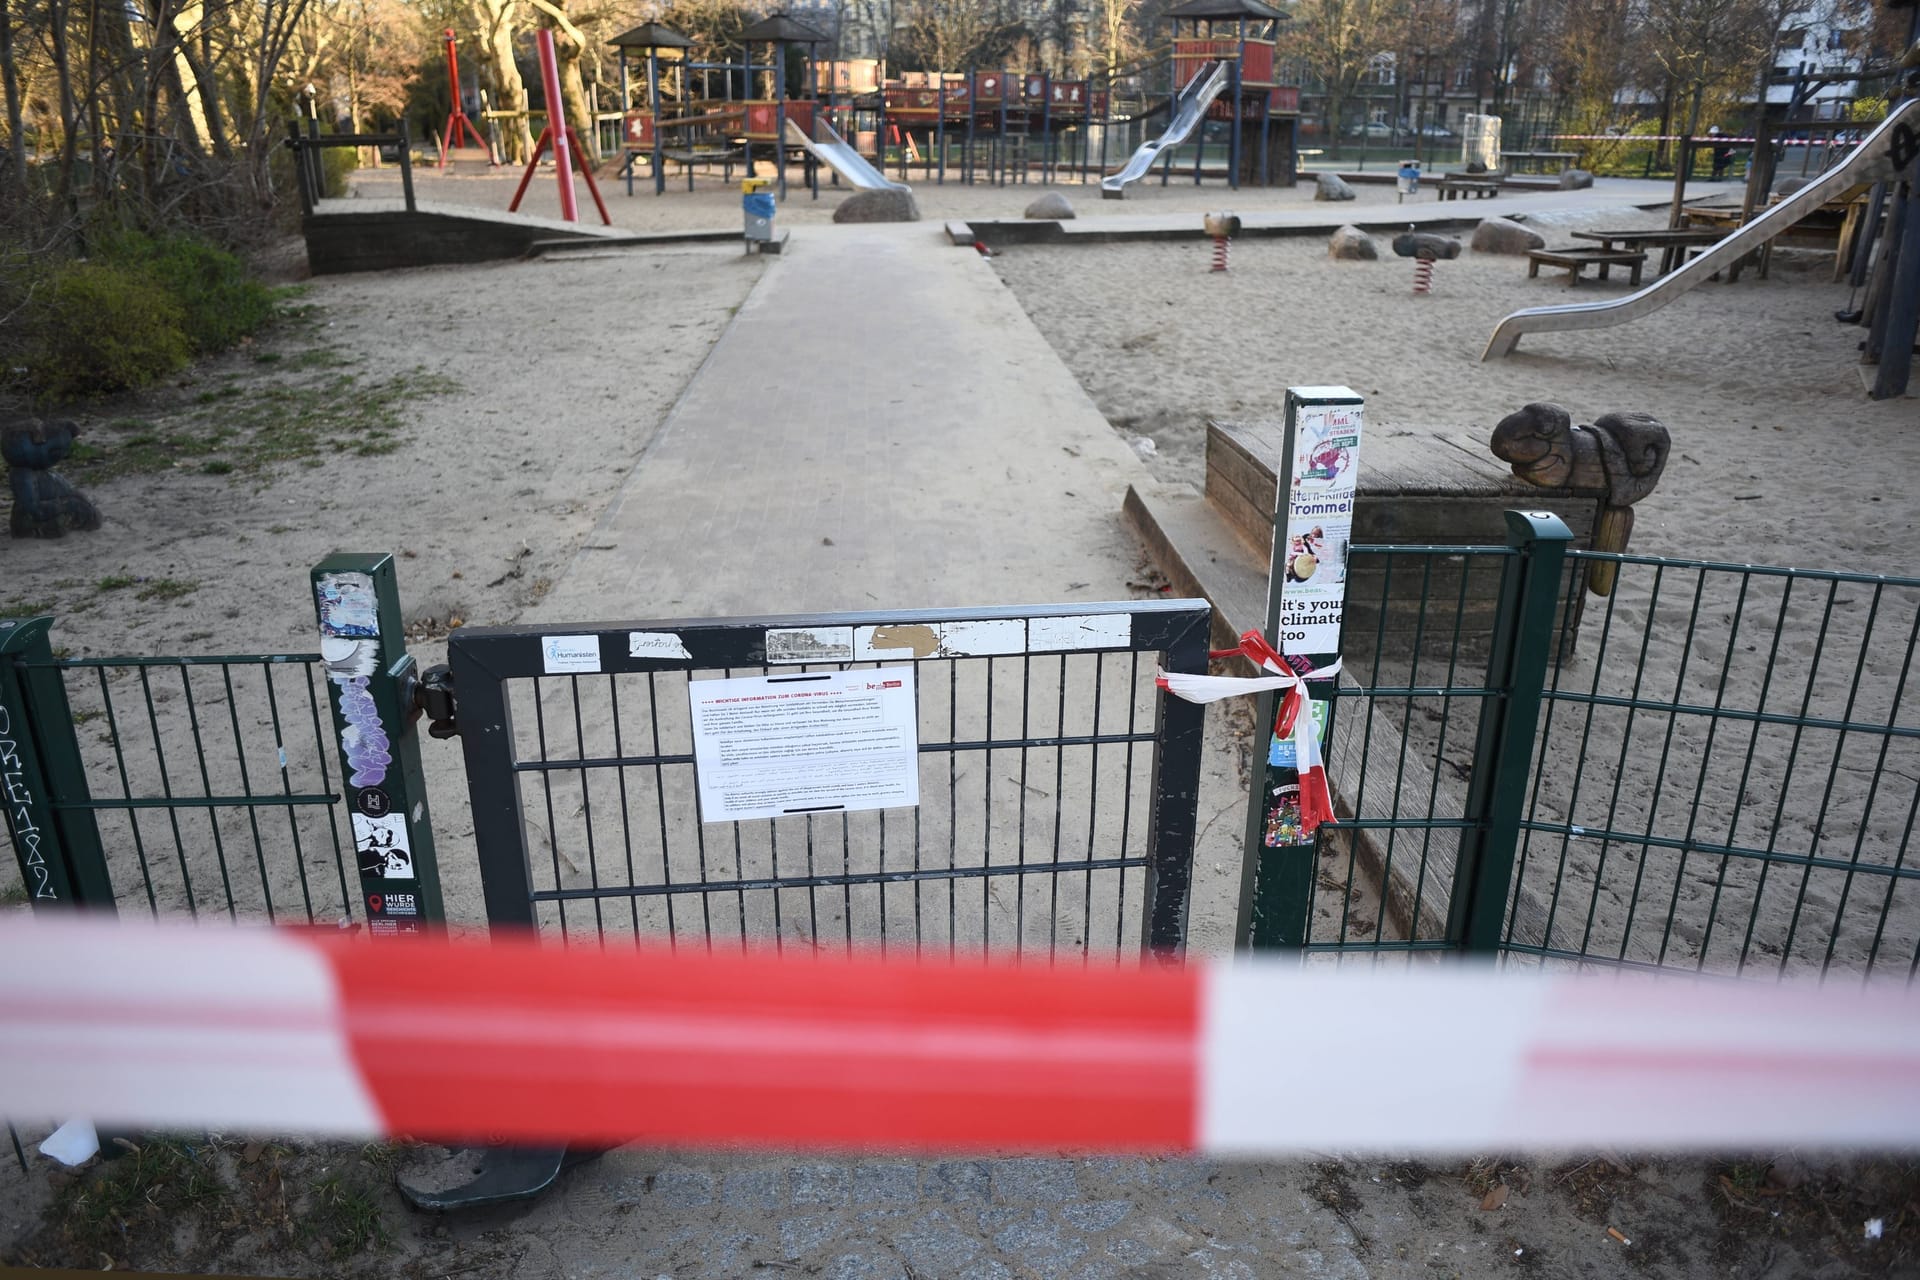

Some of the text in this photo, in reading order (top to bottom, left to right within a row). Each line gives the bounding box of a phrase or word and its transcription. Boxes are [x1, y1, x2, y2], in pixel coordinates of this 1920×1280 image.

[1289, 499, 1351, 515] Trommel
[1282, 599, 1305, 611] it's
[1281, 612, 1343, 626] climate
[1281, 629, 1305, 641] too
[741, 694, 777, 702] INFORMATION
[385, 894, 415, 903] HIER
